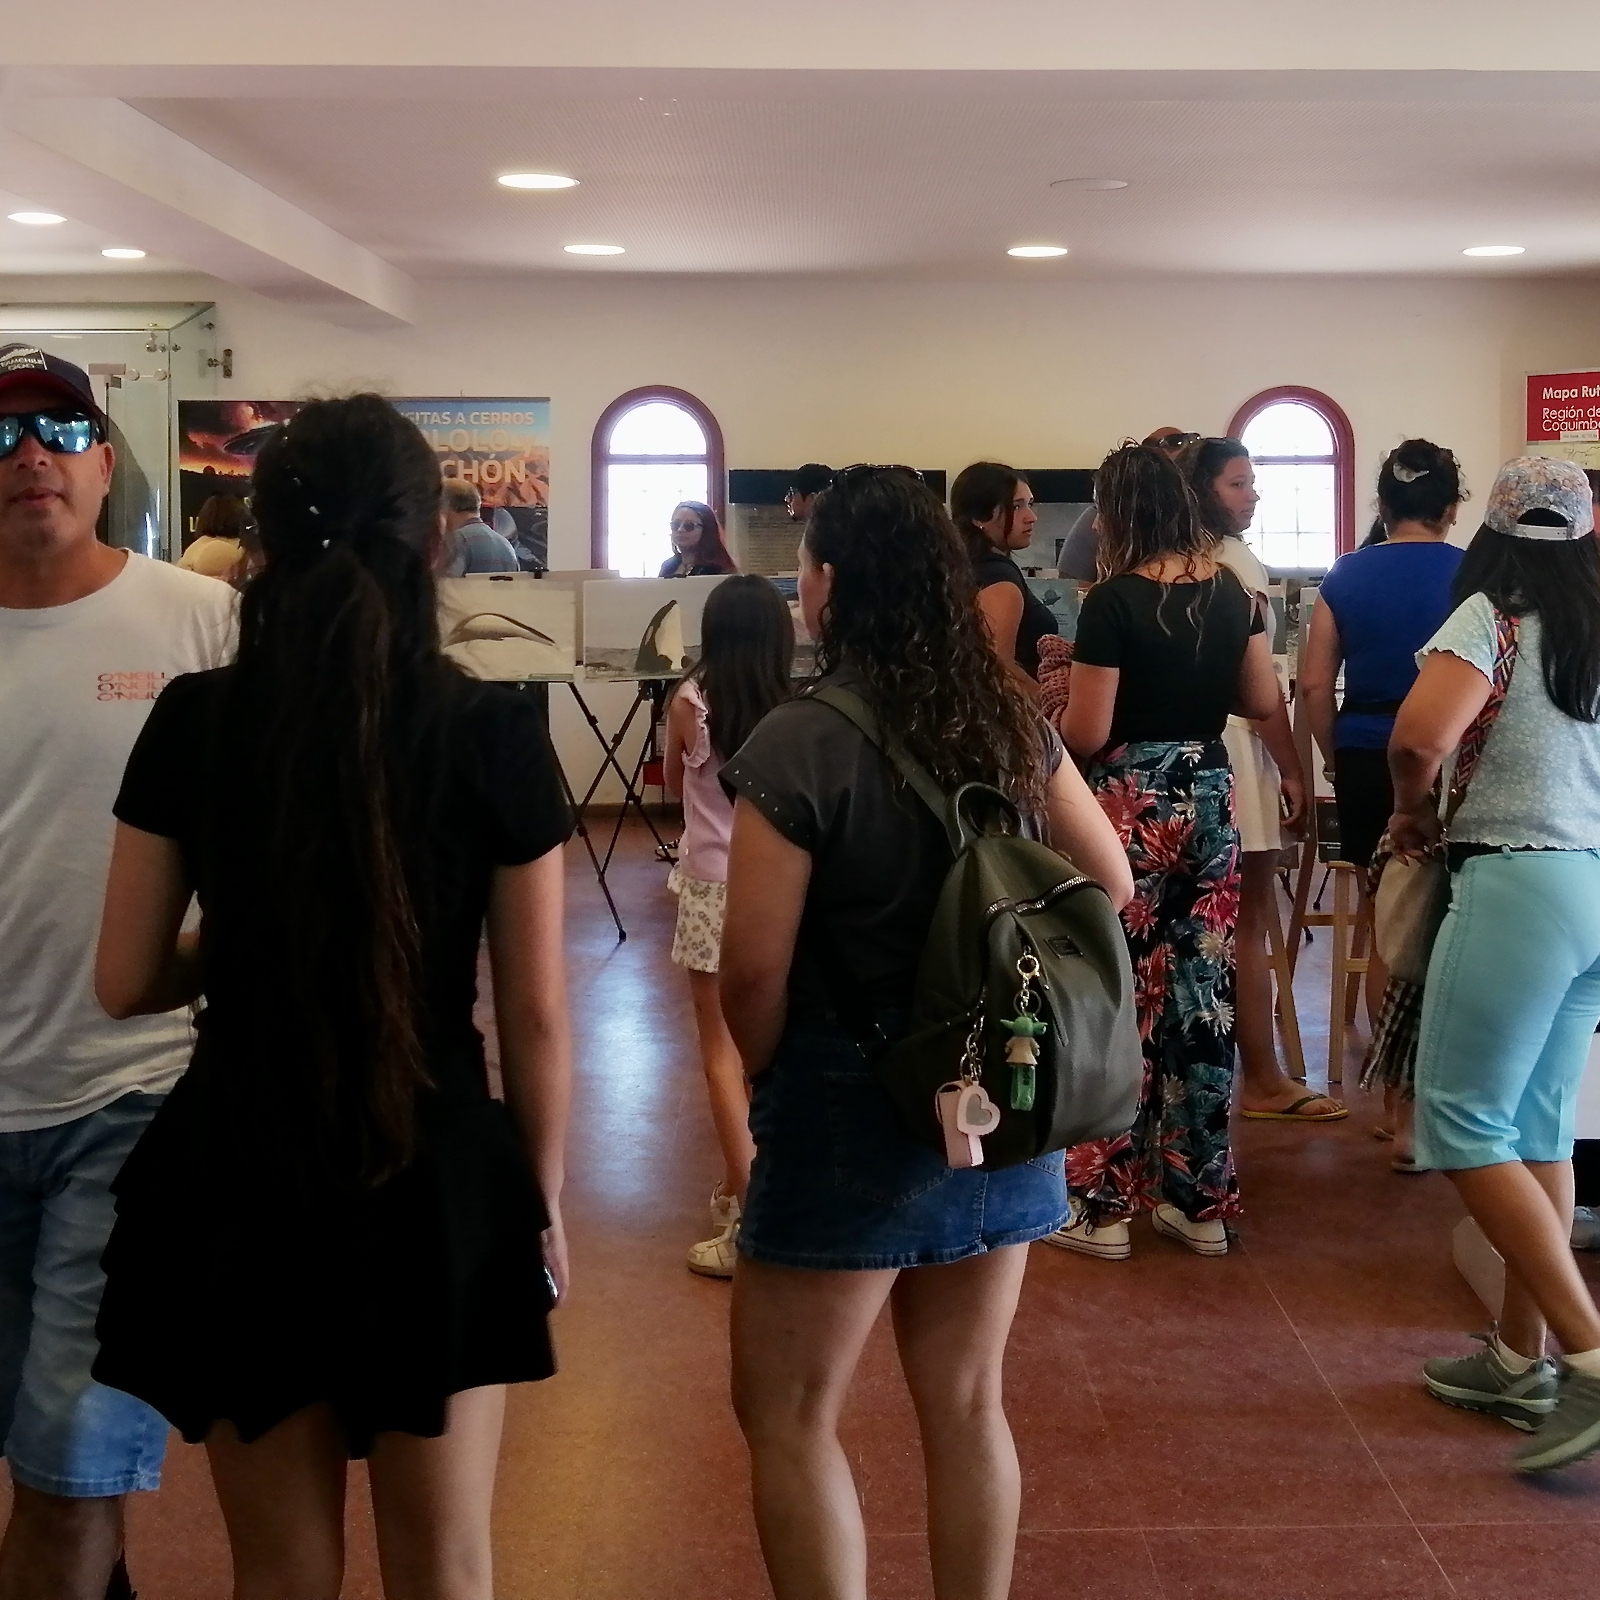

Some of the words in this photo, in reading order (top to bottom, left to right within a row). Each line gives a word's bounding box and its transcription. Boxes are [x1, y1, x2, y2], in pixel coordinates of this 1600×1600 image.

[1542, 387, 1578, 401] Mapa
[1581, 385, 1600, 398] Rut
[401, 411, 451, 425] SITAS
[455, 411, 467, 425] A
[470, 411, 535, 425] CERROS
[1542, 405, 1584, 422] Región
[440, 453, 526, 483] CHÓN
